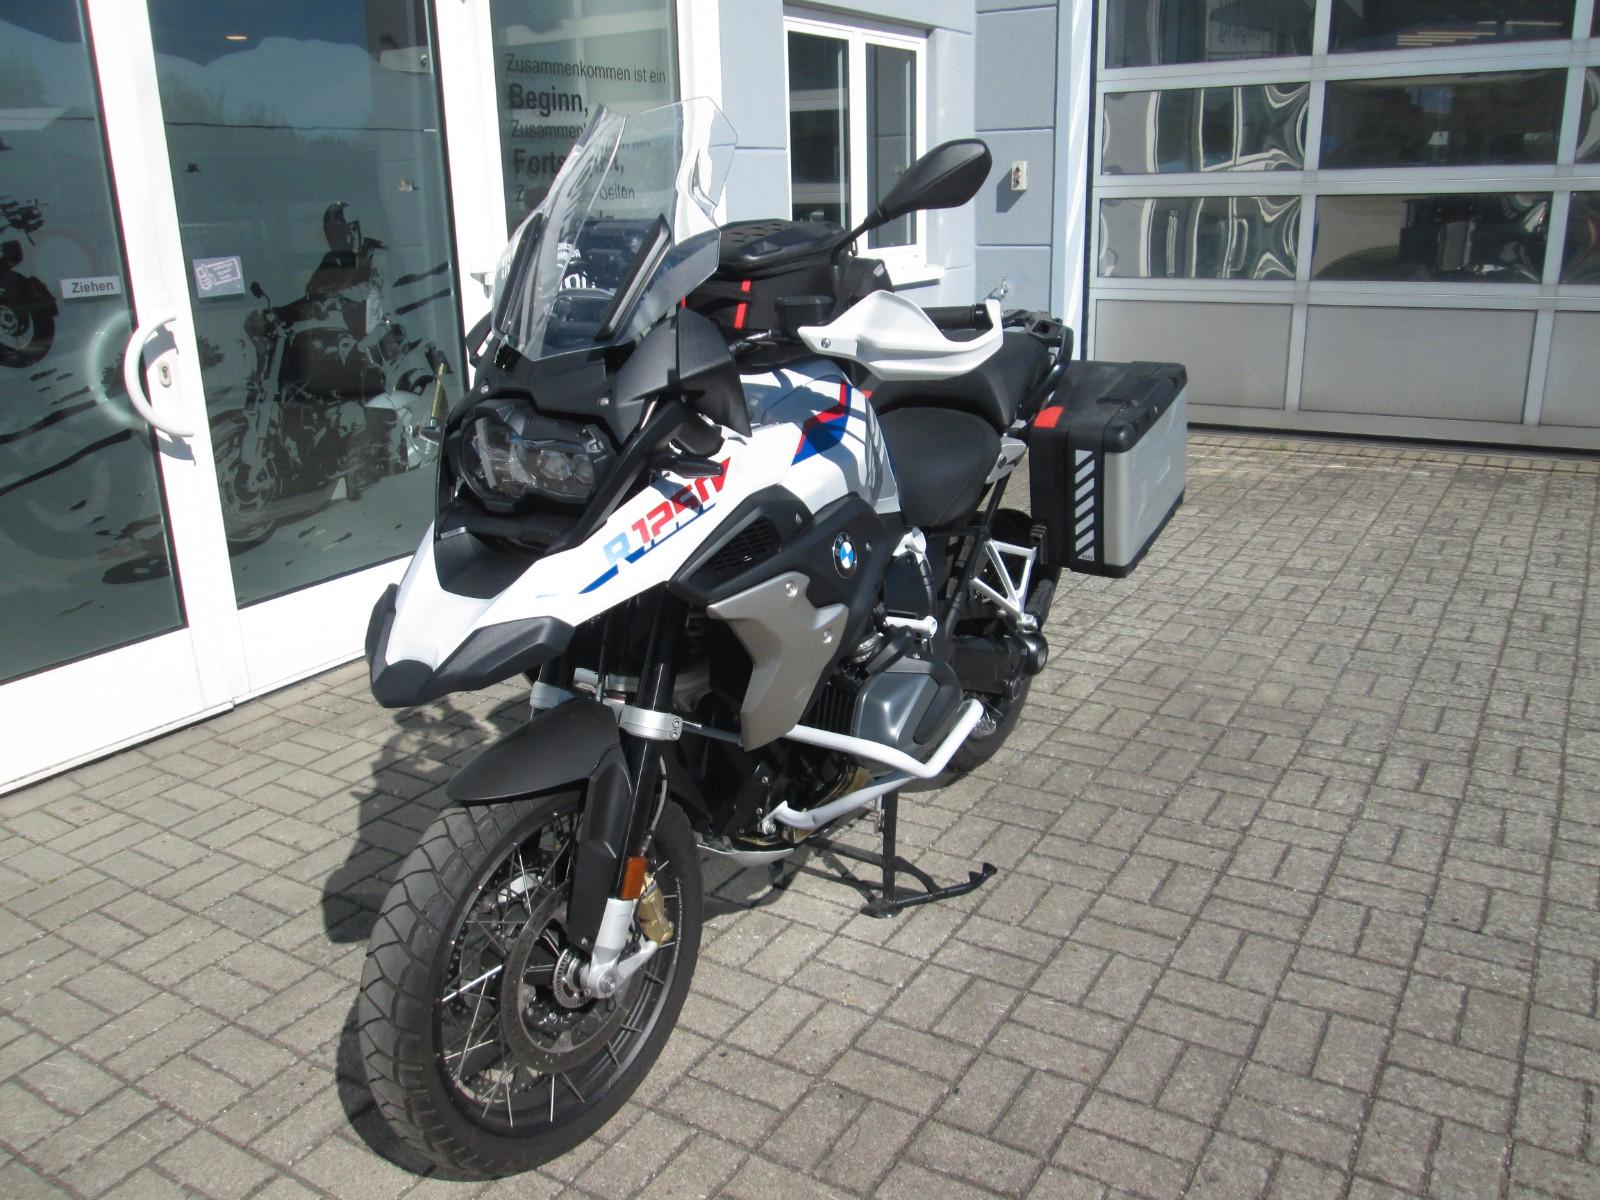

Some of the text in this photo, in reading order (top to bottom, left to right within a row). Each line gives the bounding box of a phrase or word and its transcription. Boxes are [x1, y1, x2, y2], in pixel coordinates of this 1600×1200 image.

[505, 53, 666, 84] Zusammenkommen ist ein
[508, 83, 588, 117] Beginn,
[71, 281, 114, 294] Ziehen
